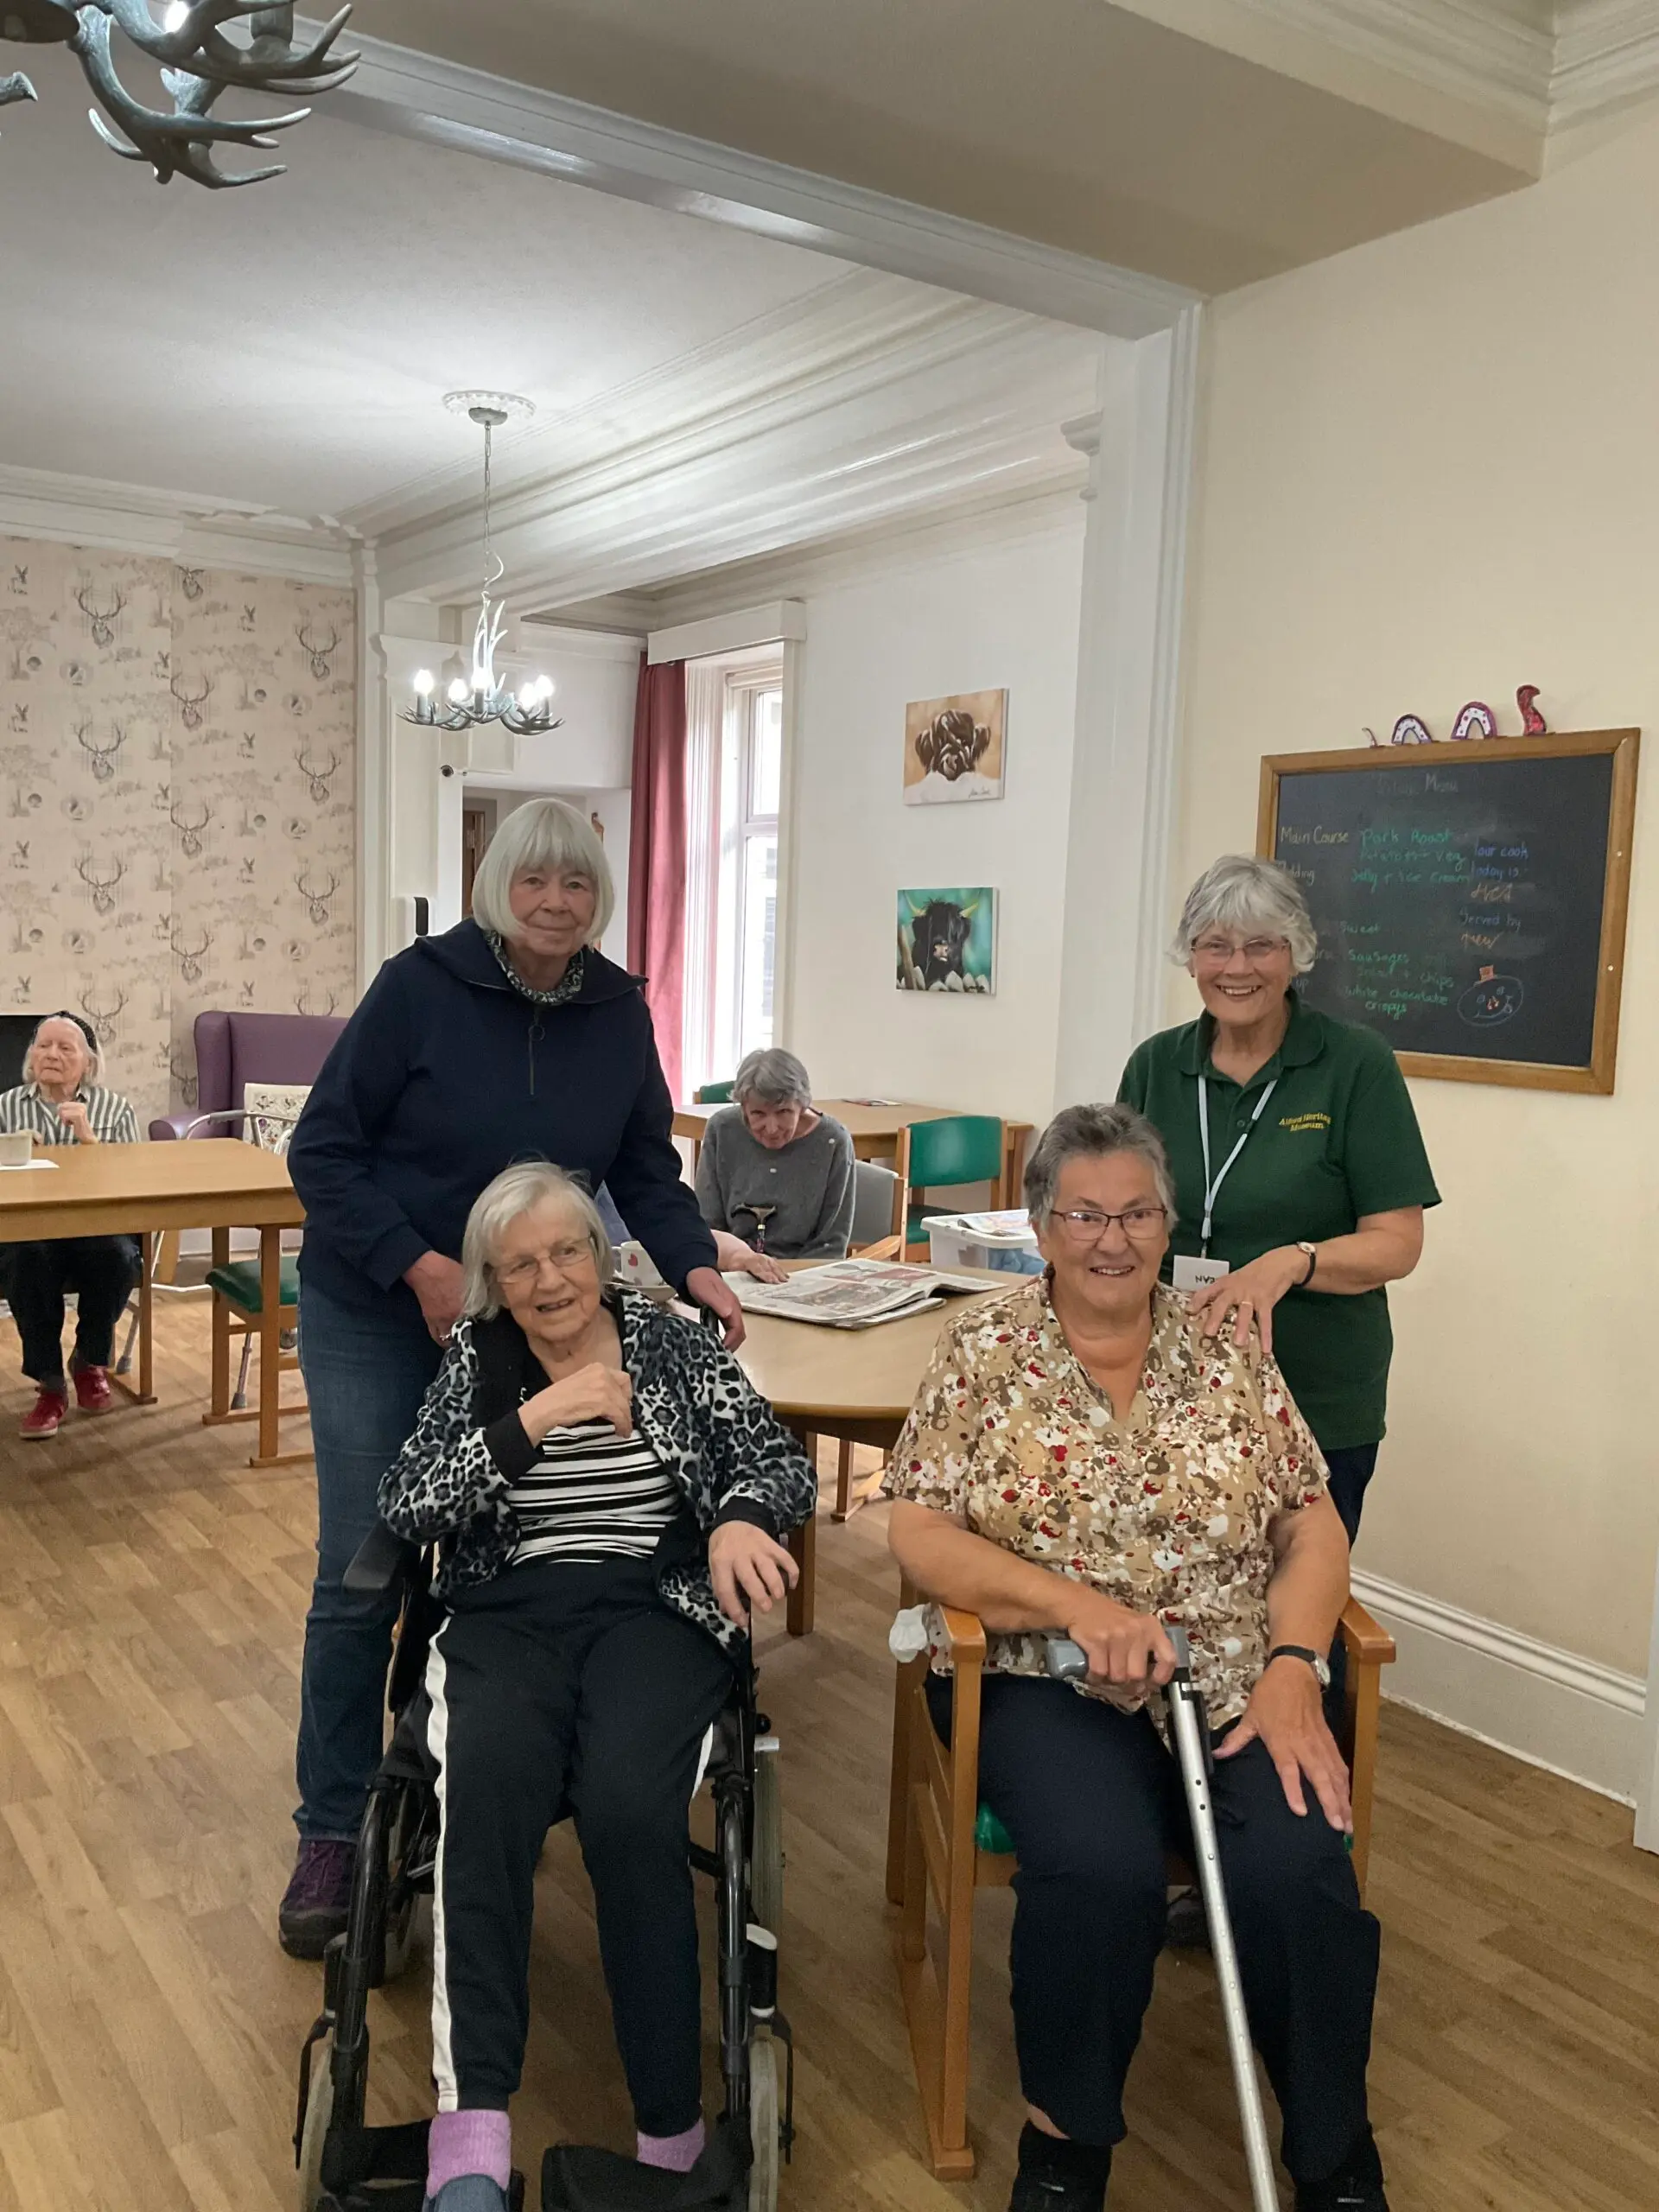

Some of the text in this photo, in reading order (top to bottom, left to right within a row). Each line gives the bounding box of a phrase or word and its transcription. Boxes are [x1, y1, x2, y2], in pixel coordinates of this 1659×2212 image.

[1281, 825, 1349, 844] Main Course
[1360, 829, 1399, 847] Pork
